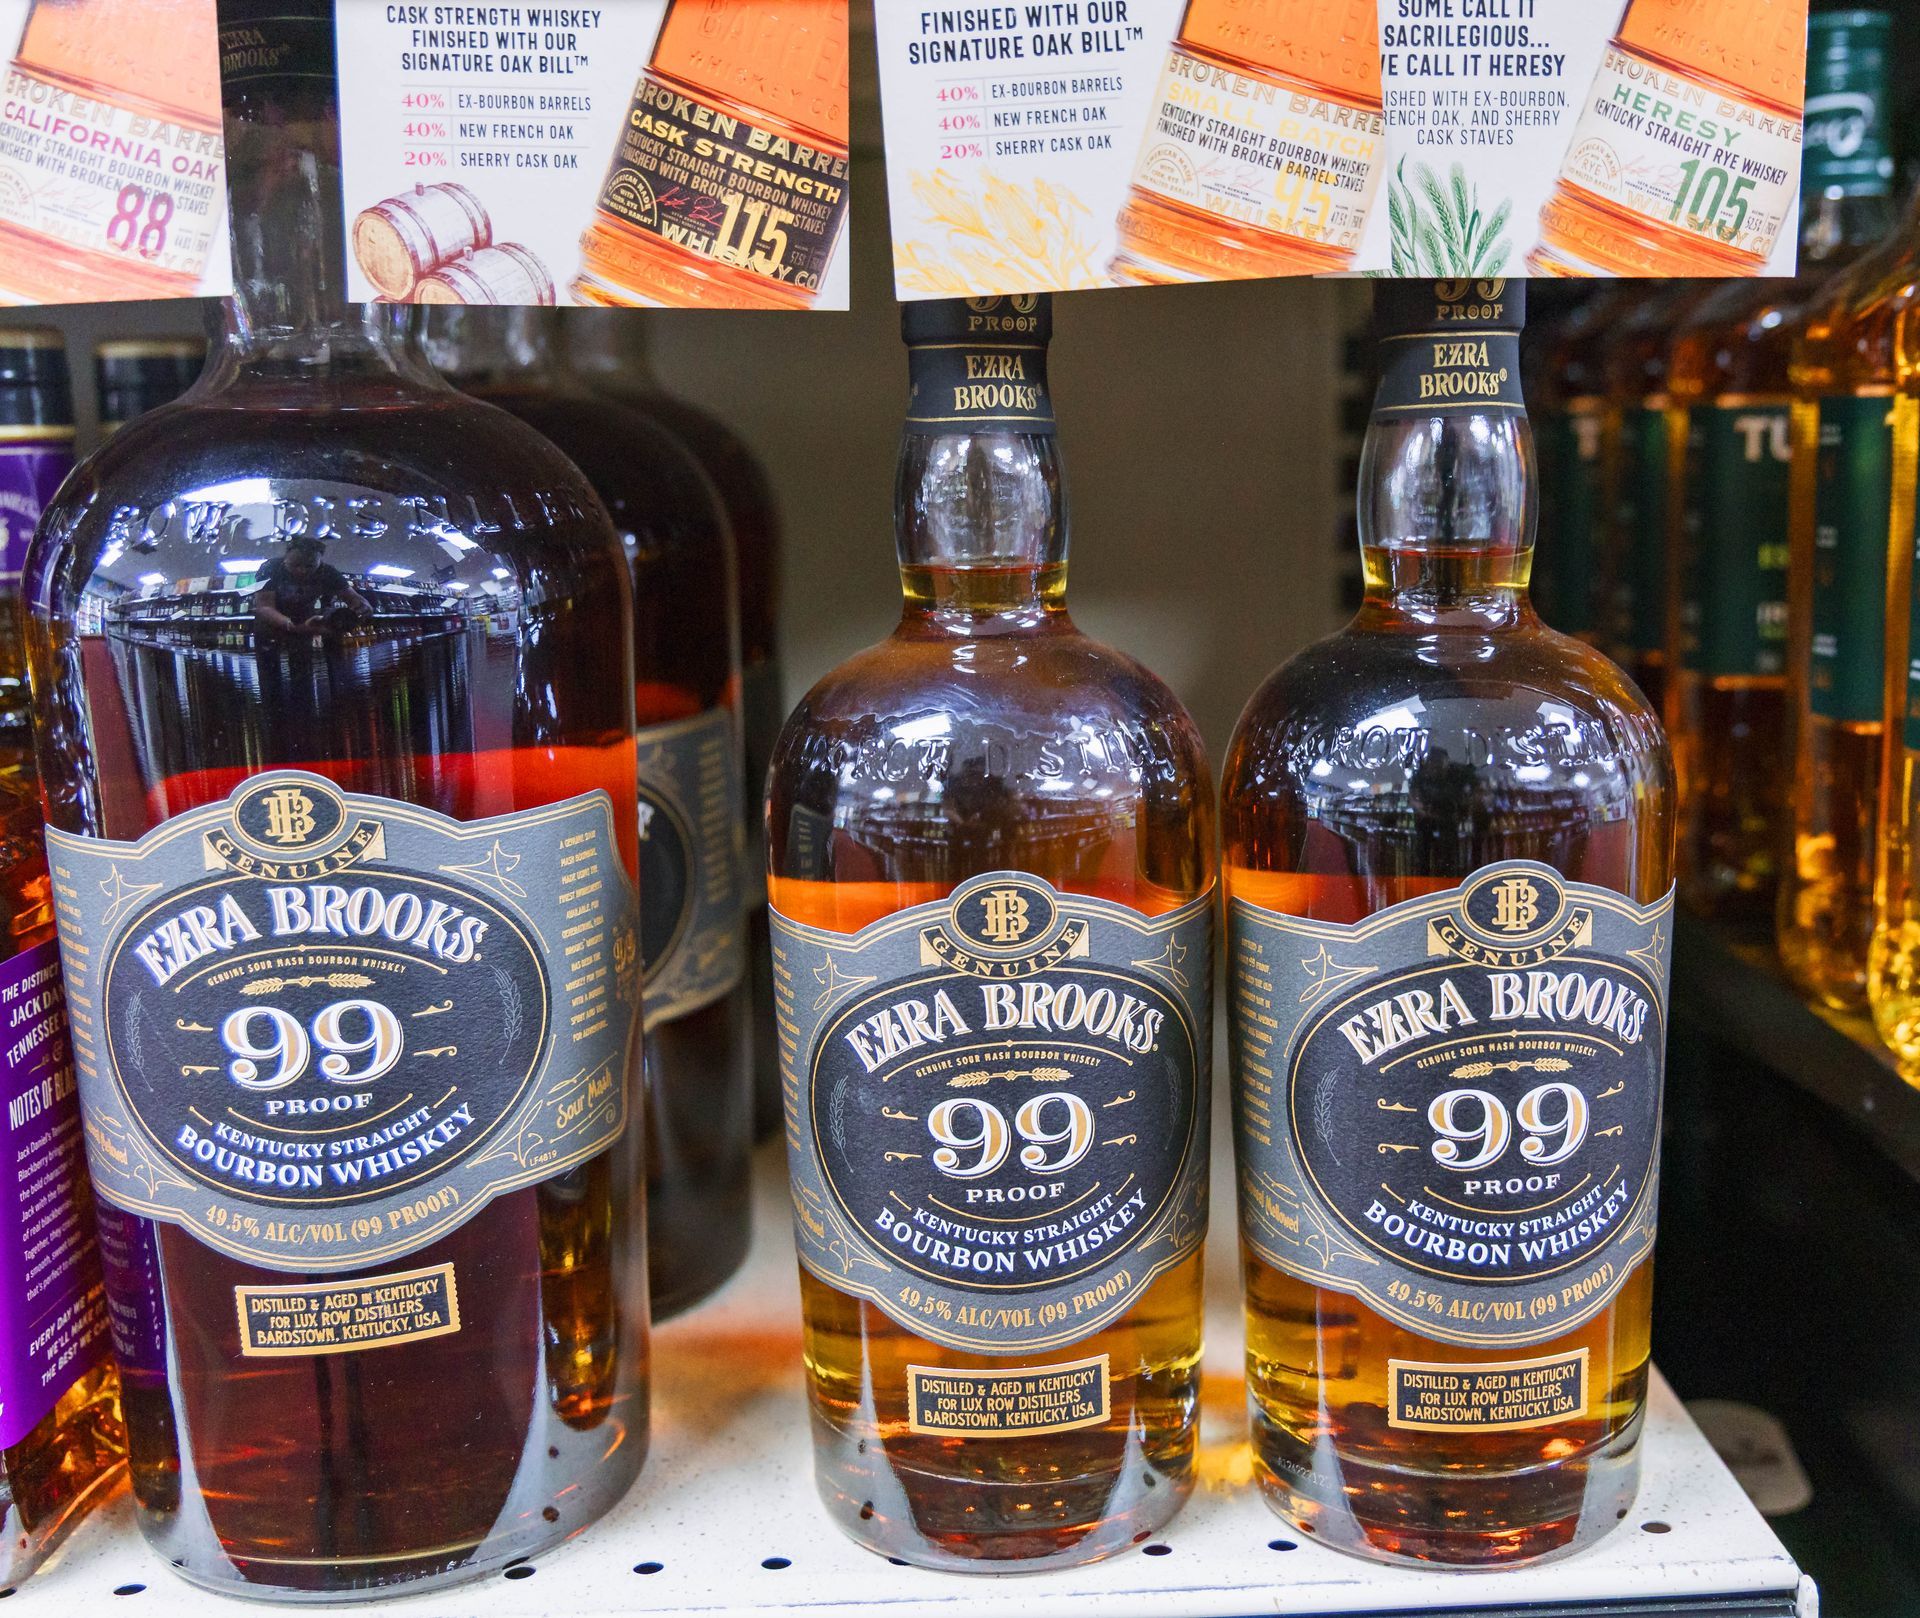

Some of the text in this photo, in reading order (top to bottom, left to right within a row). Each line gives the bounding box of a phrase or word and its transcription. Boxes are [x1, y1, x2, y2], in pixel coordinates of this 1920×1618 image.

[387, 5, 601, 28] CASK STRENGTH WHISKEY
[922, 0, 1128, 34] FINISHED WITH OUR
[1398, 0, 1534, 18] SOME CALL IT
[413, 30, 577, 51] FINISHED WITH OUR
[909, 36, 1024, 65] SIGNATURE
[1033, 33, 1073, 56] OAK
[1384, 25, 1549, 47] SACRILEGIOUS...
[402, 53, 493, 72] SIGNATURE
[501, 55, 533, 73] OAK
[1407, 54, 1455, 76] CALL
[1463, 55, 1481, 76] IT
[1489, 55, 1565, 76] HERESY
[401, 94, 591, 111] 40% EX-BOURBON BARRELS
[936, 77, 1123, 102] 40% EX-BOURBON BARRELS
[1385, 91, 1569, 107] ISHED WITH EX-BOURBON,
[402, 123, 574, 140] 40% NEW FRENCH OAK
[939, 107, 1107, 131] 40% NEW FRENCH OAK
[1167, 82, 1375, 161] SMALL BATCH
[1382, 110, 1560, 127] RENCH OAK, AND SHERRY
[1612, 83, 1742, 148] HERESY
[4, 101, 220, 182] CALIFORNIA OAK
[941, 135, 1112, 159] 20% SHERRY CASK OAK
[1417, 130, 1514, 145] CASK STAVES
[1594, 98, 1788, 186] KENTUCKY STRAIGHT RYE WHISKEY
[404, 151, 578, 169] 20% SHERRY CASK OAK
[631, 110, 841, 204] CASK STRENGTH
[1669, 158, 1756, 240] 105
[106, 183, 174, 260] 88
[716, 193, 795, 276] 115
[968, 316, 1037, 332] PROOF
[1435, 304, 1503, 321] PROOF
[965, 355, 1025, 381] EZRA
[1433, 341, 1489, 367] EZRA
[215, 829, 372, 879] GENUINE
[136, 893, 263, 987] EZRA
[931, 928, 1079, 977] GENUINE
[1440, 918, 1584, 967] GENUINE
[208, 955, 407, 985] GENUINE SOUR MASH BOURBON WHISKEY
[2, 983, 18, 1003] THE
[10, 995, 41, 1028] JACK
[1337, 978, 1479, 1065] EZRA
[7, 1012, 60, 1068] TENNESSEE
[222, 999, 404, 1091] 99
[844, 989, 972, 1073] EZRA
[9, 1077, 53, 1131] NOTES OF
[267, 1093, 373, 1115] PROOF
[557, 1095, 584, 1128] Sour
[216, 1105, 432, 1158] KENTUCKY STRAIGHT
[928, 1092, 1095, 1180] 99
[1428, 1082, 1590, 1172] 99
[177, 1124, 323, 1187] BOURBON
[330, 1102, 476, 1182] WHISKEY
[966, 1182, 1066, 1203] PROOF
[1464, 1174, 1561, 1195] PROOF
[206, 1185, 460, 1245] 49.5% ALC/VOL (99 PROOF)
[912, 1193, 1114, 1245] KENTUCKY STRAIGHT
[1363, 1180, 1628, 1266] BOURBON WHISKEY
[1407, 1185, 1602, 1238] KENTUCKY STRAIGHT
[874, 1207, 1016, 1272] BOURBON
[1023, 1188, 1148, 1270] WHISKEY
[251, 1279, 439, 1314] DISTILLED & AGED IN KENTUCKY
[899, 1269, 1132, 1330] 49.5% ALC/VOL (99 PROOF)
[1387, 1262, 1614, 1322] 49.5% ALC/VOL (99 PROOF)
[257, 1311, 441, 1345] BARDSTOWN, KENTUCKY, USA
[270, 1300, 424, 1329] FOR LUX ROW DISTILLERS
[922, 1370, 1095, 1396] DISTILLED & AGED IN KENTUCKY
[925, 1402, 1095, 1428] BARDSTOWN, KENTUCKY, USA
[938, 1389, 1081, 1411] FOR LUX ROW DISTILLERS
